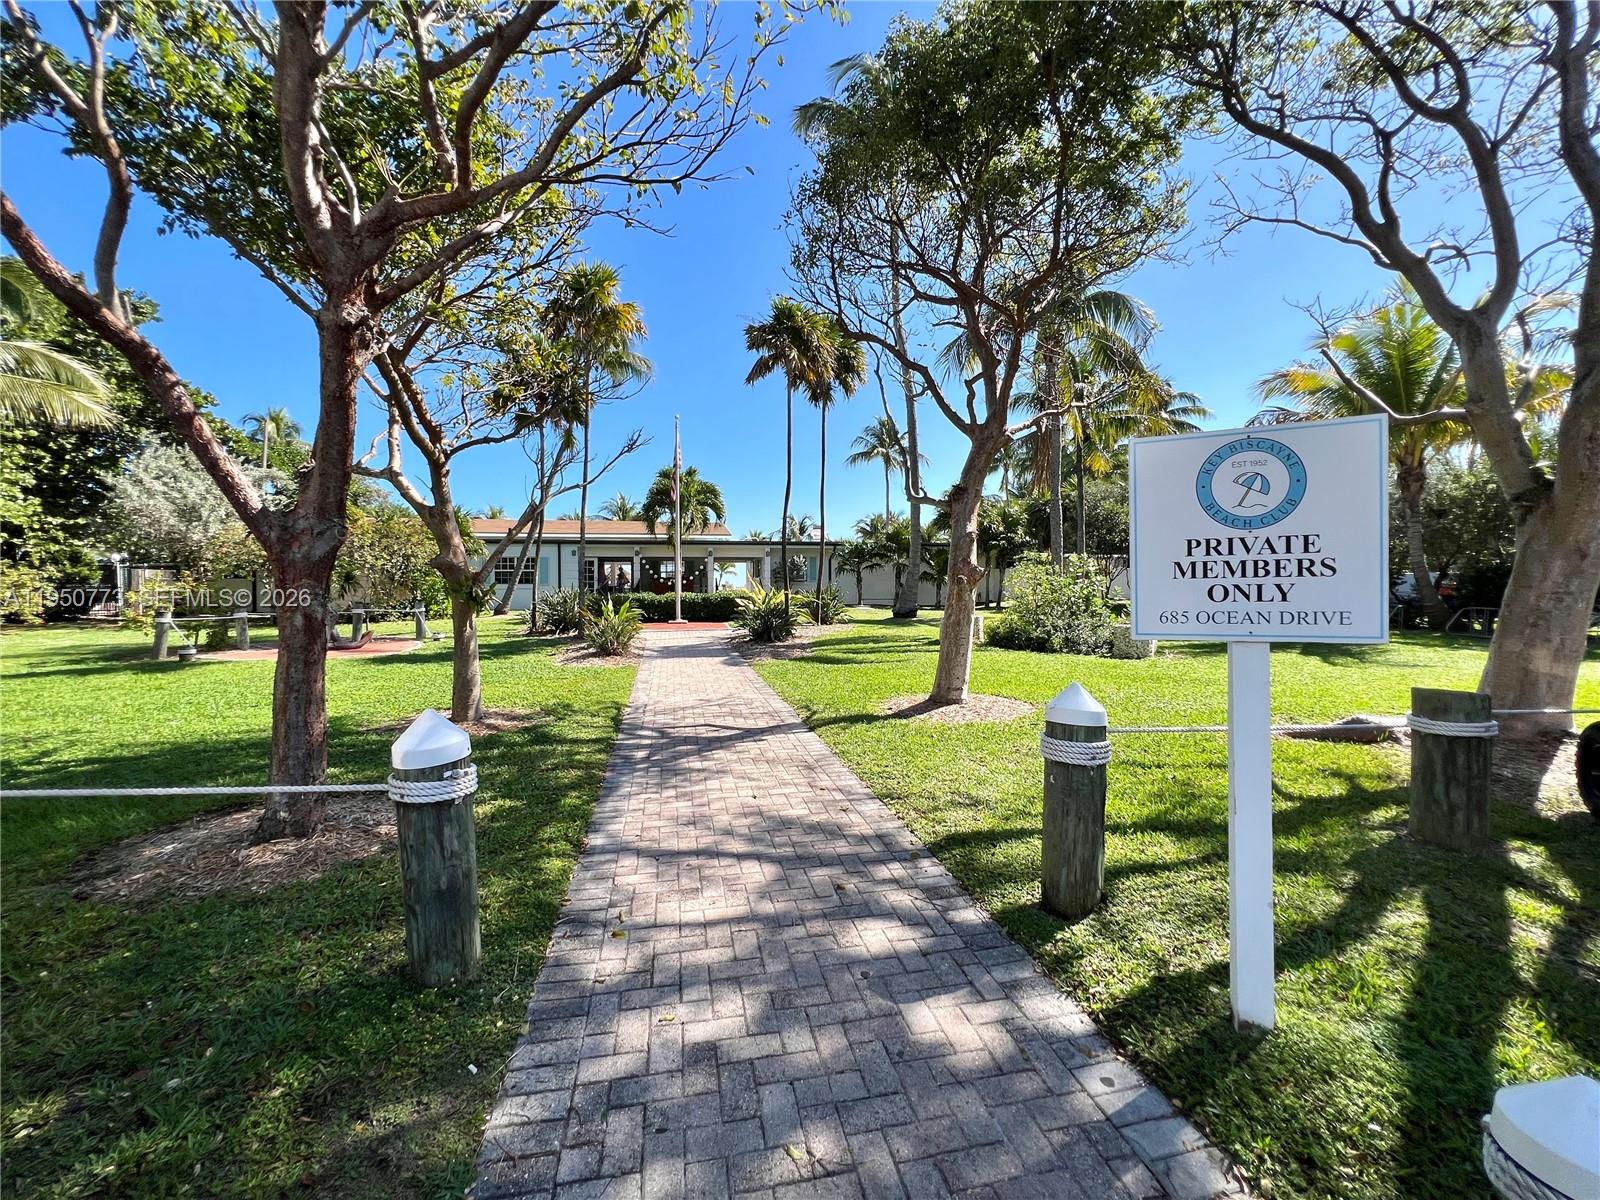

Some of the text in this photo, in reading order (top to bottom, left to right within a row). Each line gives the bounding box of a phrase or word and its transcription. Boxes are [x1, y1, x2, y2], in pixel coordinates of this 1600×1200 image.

[1202, 440, 1300, 476] KEY BISCAYNE
[1231, 459, 1268, 469] EST 1952
[1205, 498, 1297, 528] BEACH CLUB
[1184, 534, 1321, 557] PRIVATE
[1172, 557, 1337, 580] MEMBERS
[1207, 583, 1296, 603] ONLY
[1159, 610, 1353, 626] 685 OCEAN DRIVE
